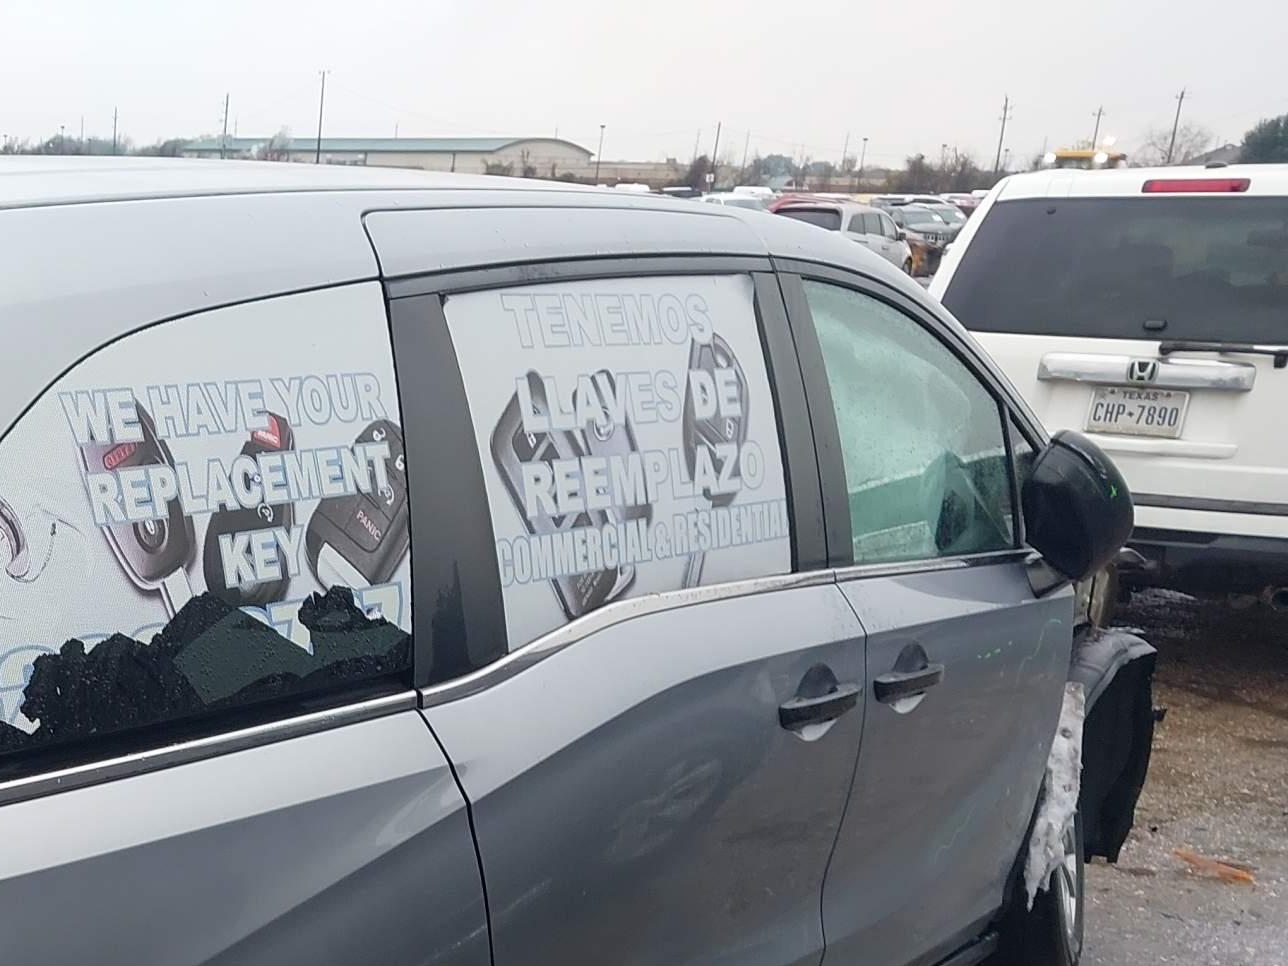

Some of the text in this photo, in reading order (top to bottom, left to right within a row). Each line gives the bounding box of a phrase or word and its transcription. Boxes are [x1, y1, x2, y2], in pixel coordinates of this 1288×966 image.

[500, 293, 713, 349] TENEMOS
[57, 372, 390, 446] WE HAVE YOUR
[515, 365, 743, 433] LLAVES DE
[1122, 390, 1160, 401] TEXAS
[86, 440, 392, 528] REPLACEMENT
[522, 440, 766, 520] REEMPLAZO
[218, 524, 306, 589] KEY
[356, 510, 382, 542] PANIC
[497, 517, 653, 588] COMMERCIAL
[652, 521, 674, 561] &
